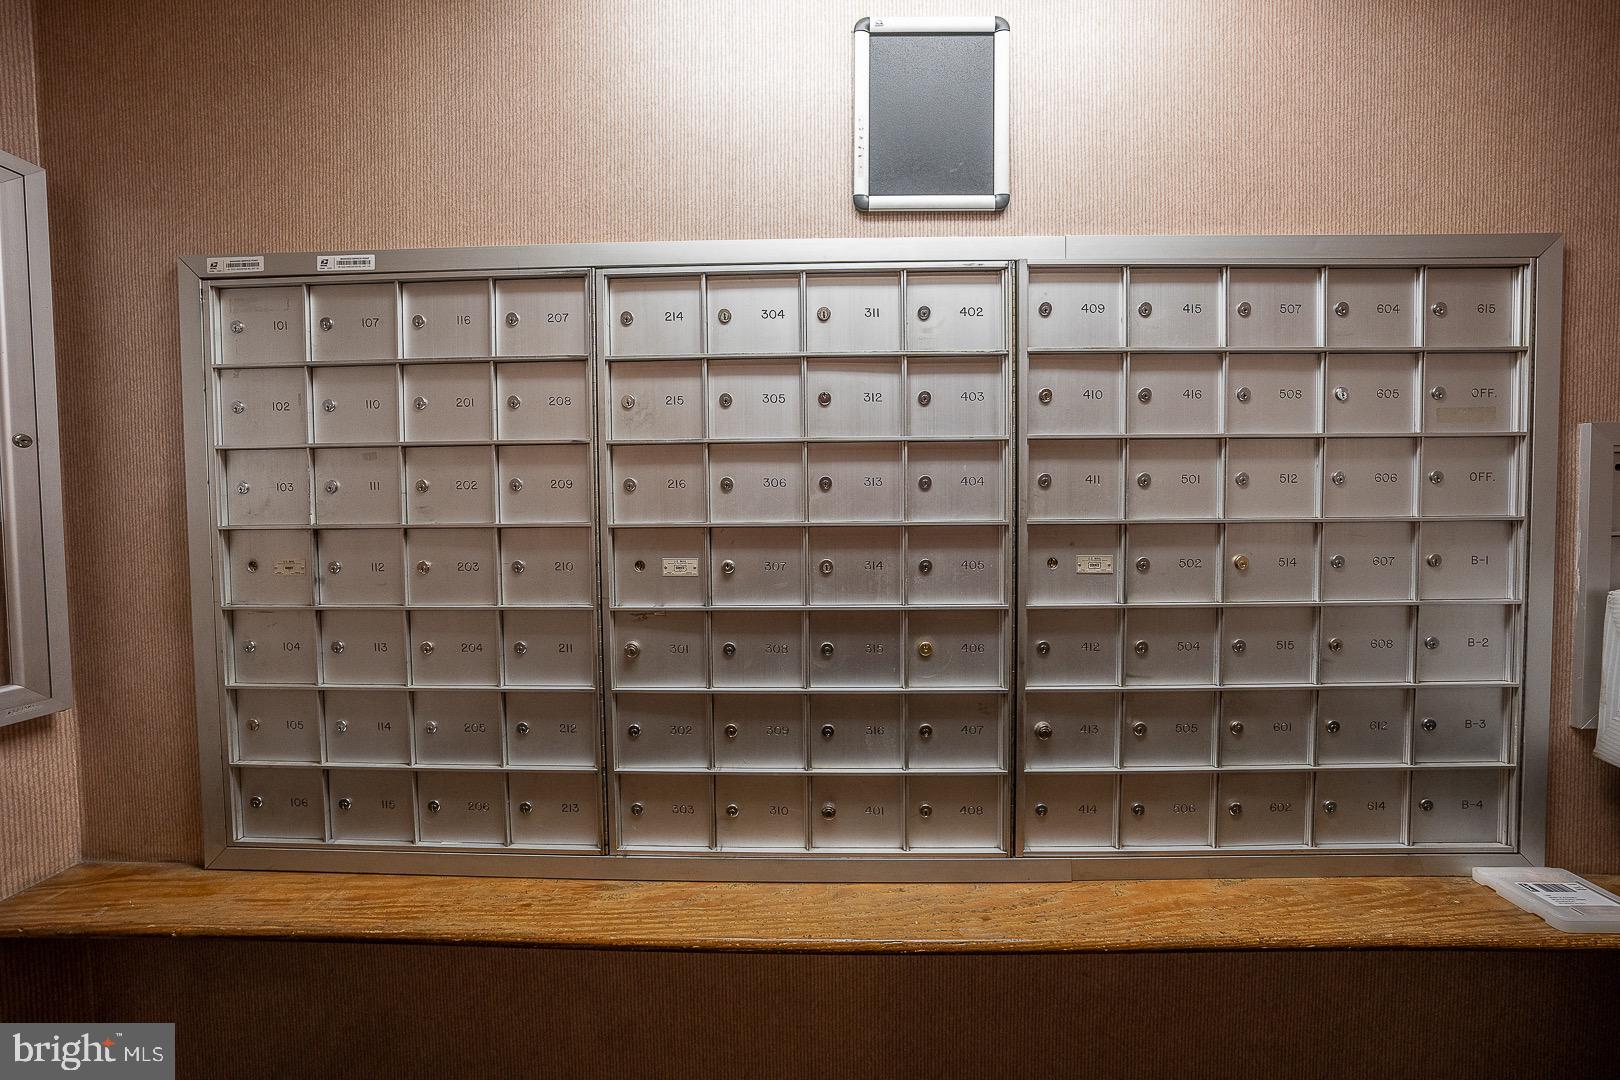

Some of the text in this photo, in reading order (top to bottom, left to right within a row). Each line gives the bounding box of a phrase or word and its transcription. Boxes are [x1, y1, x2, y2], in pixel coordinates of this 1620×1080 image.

[864, 307, 880, 318] 311
[959, 306, 984, 317] 402
[1080, 303, 1106, 314] 409
[1182, 303, 1202, 314] 415
[1279, 303, 1302, 314] 507
[1376, 303, 1401, 315] 604
[1477, 303, 1496, 314] 615
[547, 312, 569, 323] 207
[664, 311, 684, 322] 214
[761, 309, 786, 320] 304
[273, 320, 288, 331] 101
[361, 317, 380, 328] 107
[456, 315, 471, 326] 116
[863, 392, 882, 403] 312
[960, 391, 985, 402] 403
[1082, 389, 1103, 400] 410
[1182, 389, 1202, 400] 416
[1279, 388, 1303, 400] 508
[1376, 388, 1400, 399] 605
[1470, 386, 1498, 399] OFF.
[455, 397, 474, 408] 201
[548, 396, 572, 407] 208
[665, 395, 685, 406] 215
[762, 393, 786, 404] 305
[272, 401, 291, 412] 102
[365, 399, 381, 410] 110
[863, 477, 883, 487] 313
[960, 476, 985, 487] 404
[1084, 474, 1100, 485] 411
[1181, 473, 1201, 485] 501
[1279, 473, 1298, 484] 512
[1374, 472, 1398, 483] 606
[1468, 471, 1497, 482] OFF.
[275, 481, 294, 493] 103
[369, 481, 380, 491] 111
[455, 480, 478, 490] 202
[550, 479, 573, 489] 209
[667, 478, 687, 489] 216
[763, 477, 787, 488] 306
[764, 561, 787, 571] 307
[863, 560, 884, 571] 314
[960, 560, 985, 570] 405
[1178, 558, 1202, 569] 502
[1278, 557, 1297, 568] 514
[1372, 556, 1396, 567] 607
[1471, 555, 1489, 566] B-1
[371, 562, 385, 573] 112
[457, 561, 480, 572] 203
[554, 561, 574, 572] 210
[282, 641, 301, 652] 104
[374, 642, 388, 653] 113
[460, 642, 483, 653] 204
[558, 643, 573, 653] 211
[960, 643, 985, 653] 406
[1080, 642, 1101, 652] 412
[1176, 641, 1200, 652] 504
[1275, 640, 1295, 651] 515
[1370, 638, 1394, 649] 608
[1467, 637, 1489, 648] B-2
[669, 644, 689, 654] 301
[766, 643, 789, 654] 308
[865, 643, 884, 654] 315
[286, 720, 304, 730] 105
[377, 721, 392, 732] 114
[464, 722, 487, 733] 205
[559, 723, 577, 734] 212
[1080, 724, 1100, 735] 413
[1175, 722, 1199, 734] 505
[1272, 722, 1292, 732] 601
[1369, 720, 1389, 731] 612
[1464, 719, 1487, 729] B-3
[669, 725, 693, 735] 302
[766, 725, 790, 737] 309
[866, 725, 886, 736] 316
[960, 725, 984, 736] 407
[290, 797, 309, 808] 106
[381, 799, 396, 810] 115
[467, 801, 490, 813] 206
[561, 803, 580, 813] 213
[1269, 802, 1293, 813] 602
[1367, 800, 1386, 811] 614
[1461, 799, 1484, 810] B-4
[671, 804, 695, 815] 303
[769, 805, 789, 816] 310
[863, 806, 884, 816] 401
[959, 805, 985, 816] 408
[1078, 804, 1097, 814] 414
[1172, 804, 1196, 815] 506
